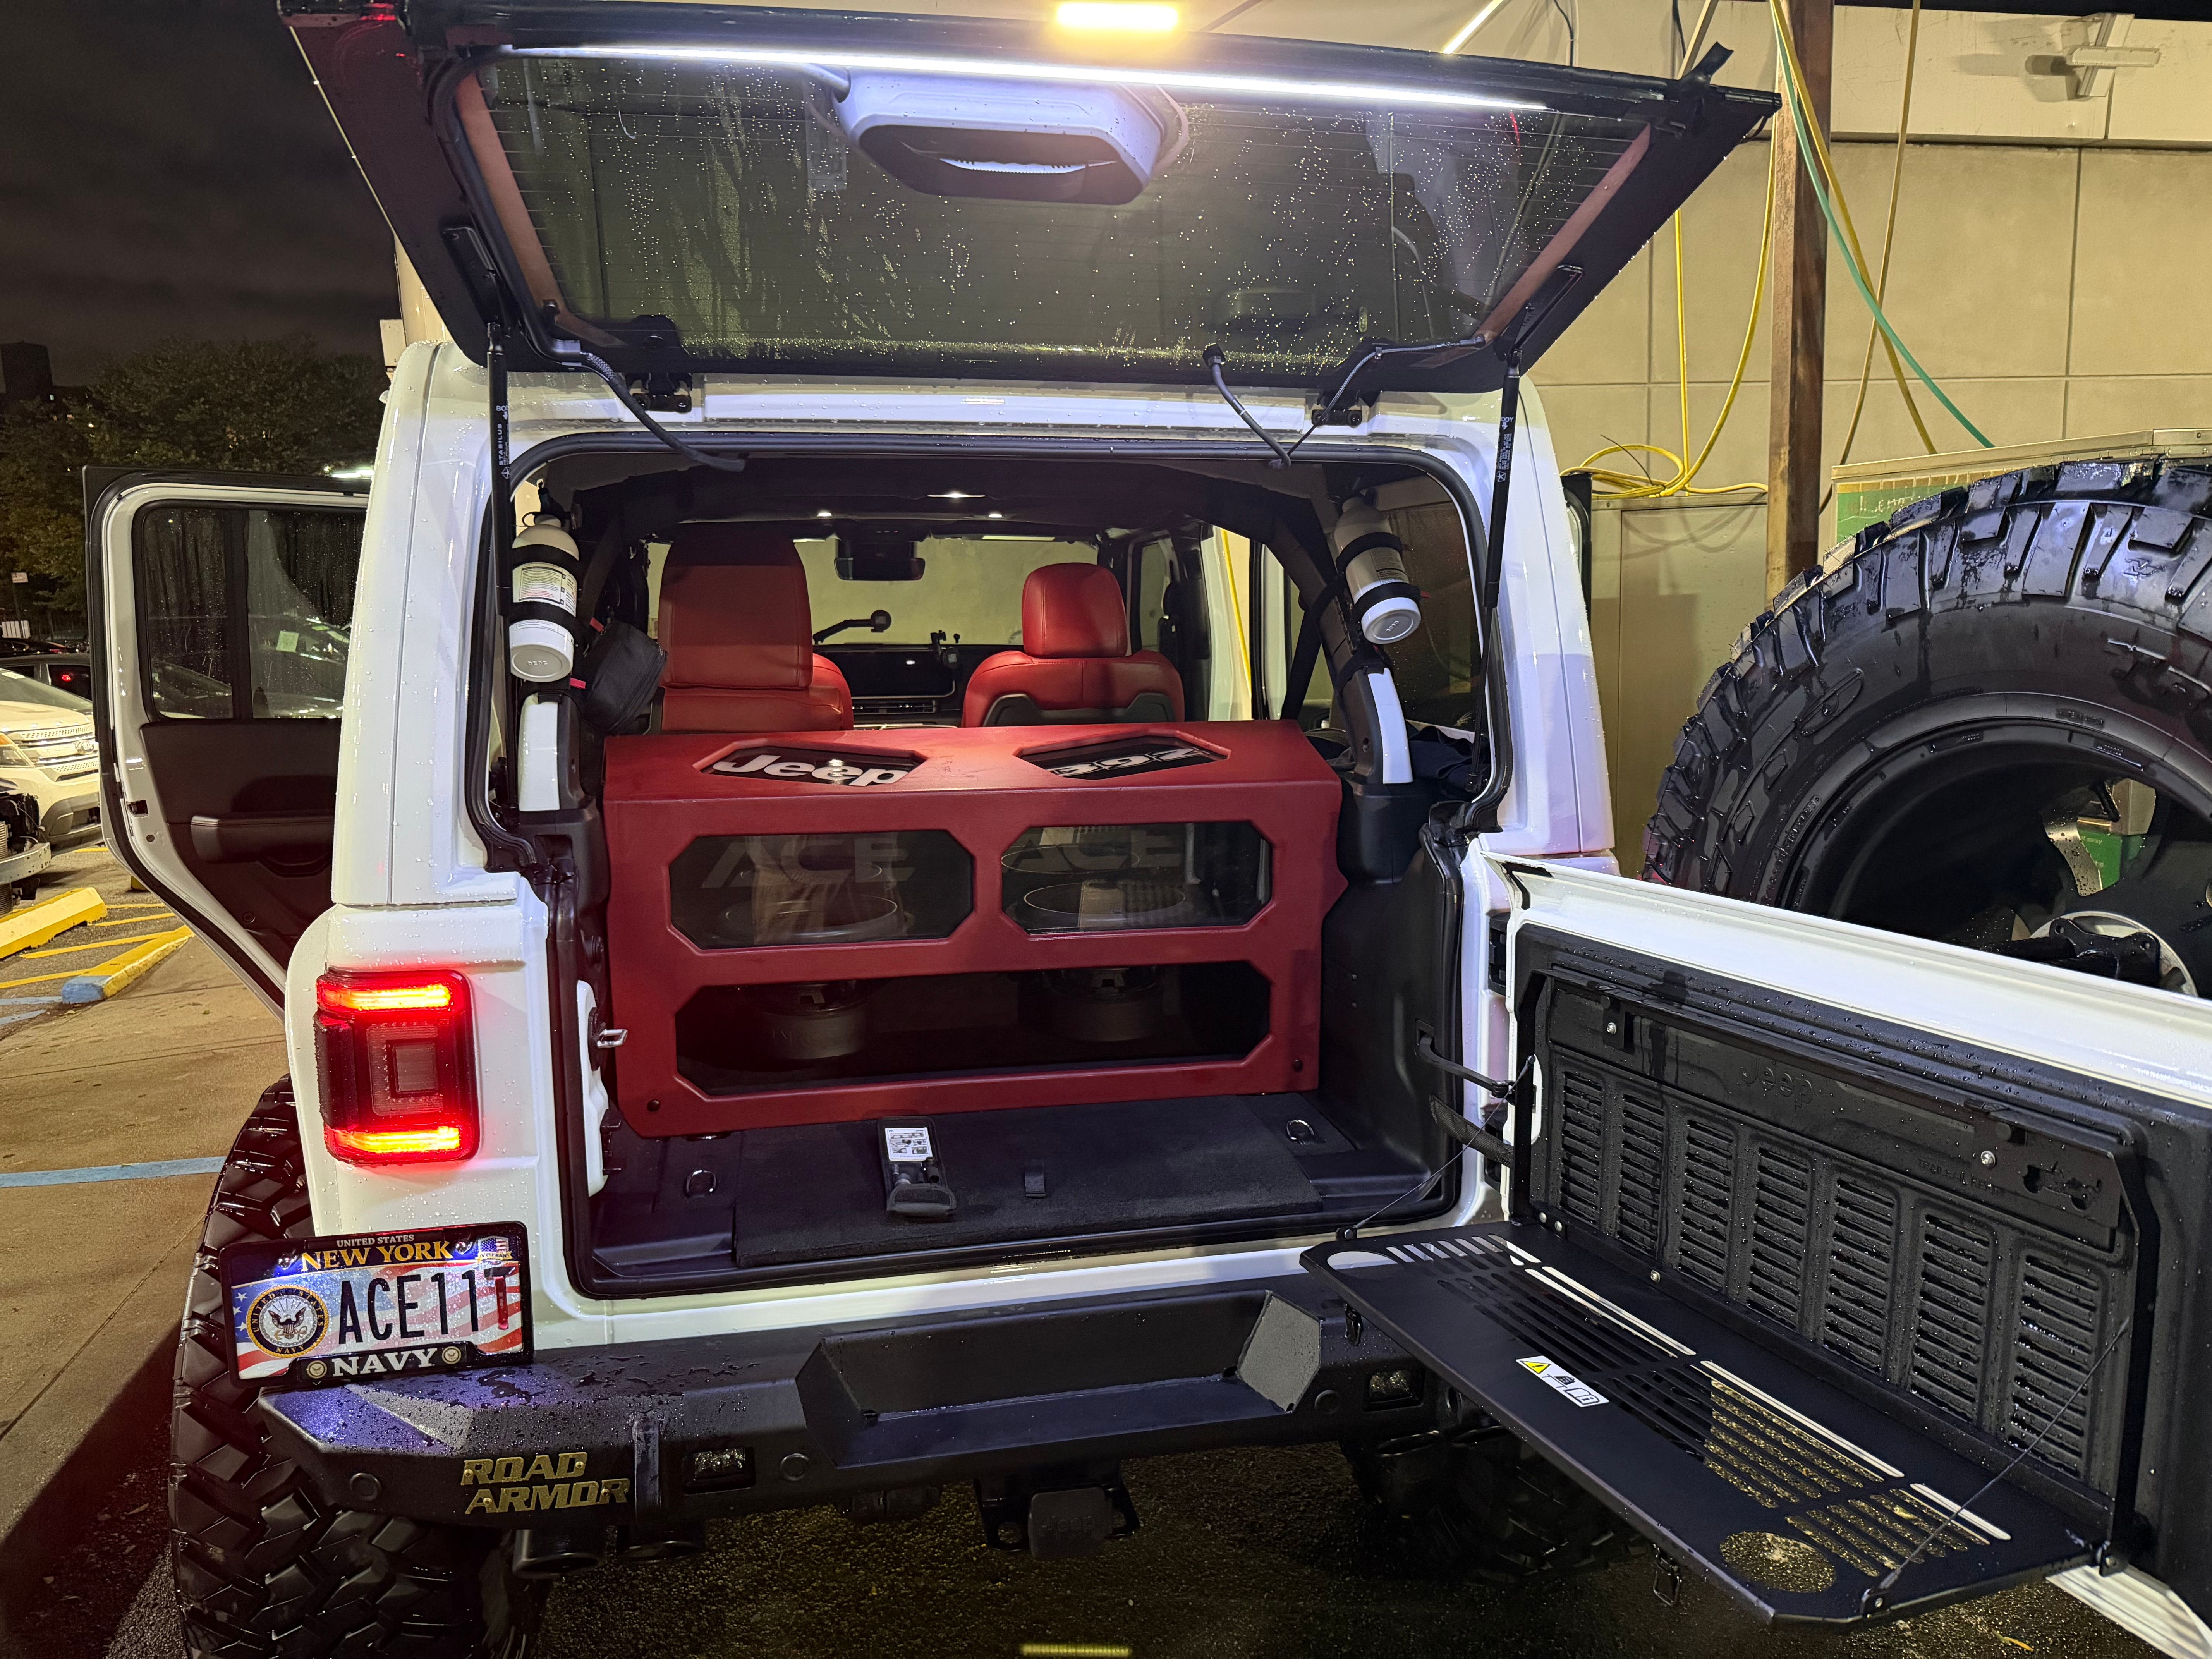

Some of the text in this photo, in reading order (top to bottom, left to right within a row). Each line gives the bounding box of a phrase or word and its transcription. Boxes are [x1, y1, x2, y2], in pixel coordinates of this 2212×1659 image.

[713, 754, 909, 786] Jeep
[1738, 1058, 1815, 1112] Jeep
[302, 1240, 454, 1273] NEW YORK
[337, 1234, 414, 1247] UNITED STATES
[252, 1291, 324, 1333] UNITED STATES
[338, 1266, 515, 1345] ACE11T
[276, 1344, 305, 1353] NAVY
[333, 1348, 436, 1377] NAVY
[460, 1452, 588, 1486] ROAD
[465, 1478, 630, 1514] ARMOR
